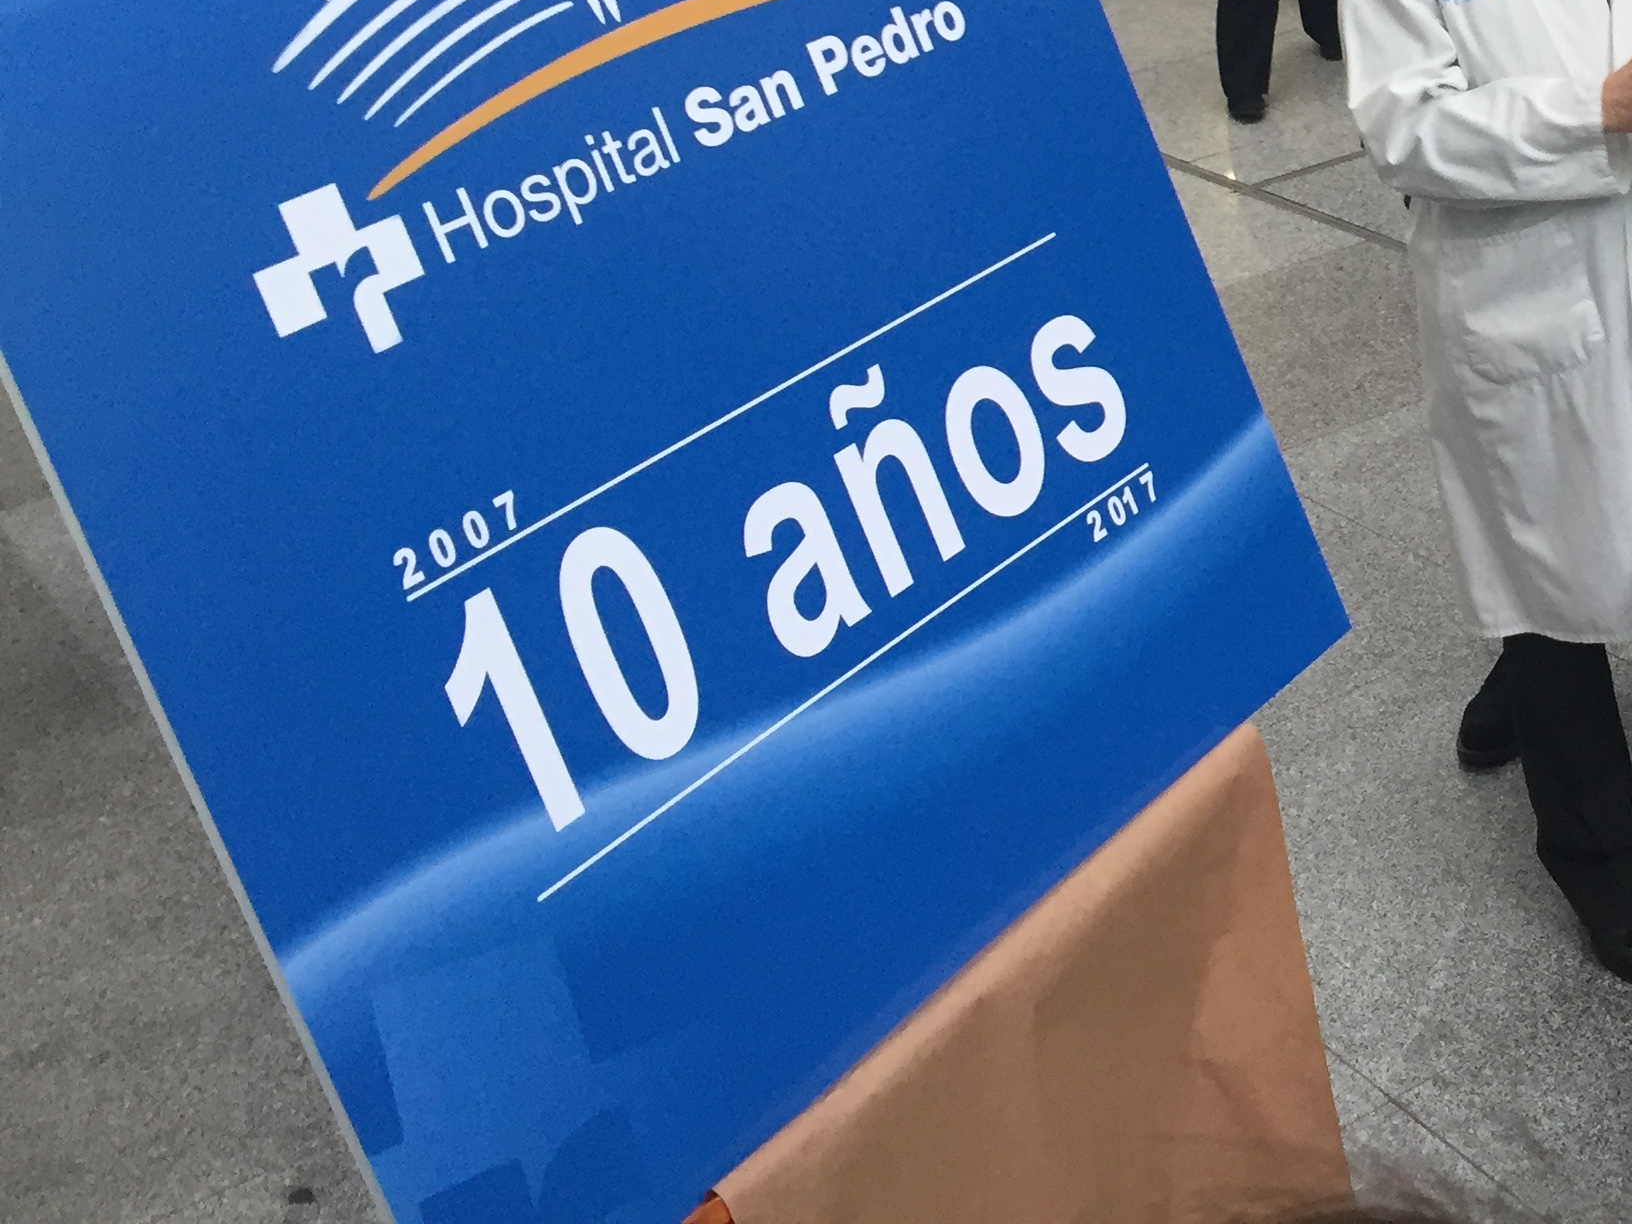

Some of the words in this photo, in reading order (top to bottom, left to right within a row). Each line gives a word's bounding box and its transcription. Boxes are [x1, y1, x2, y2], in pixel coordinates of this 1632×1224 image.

[423, 107, 680, 263] Hospital
[685, 70, 805, 147] San
[805, 2, 965, 96] Pedro
[393, 491, 517, 590] 2007
[444, 526, 699, 832] 10
[743, 315, 1127, 657] años
[1086, 471, 1158, 543] 2017
